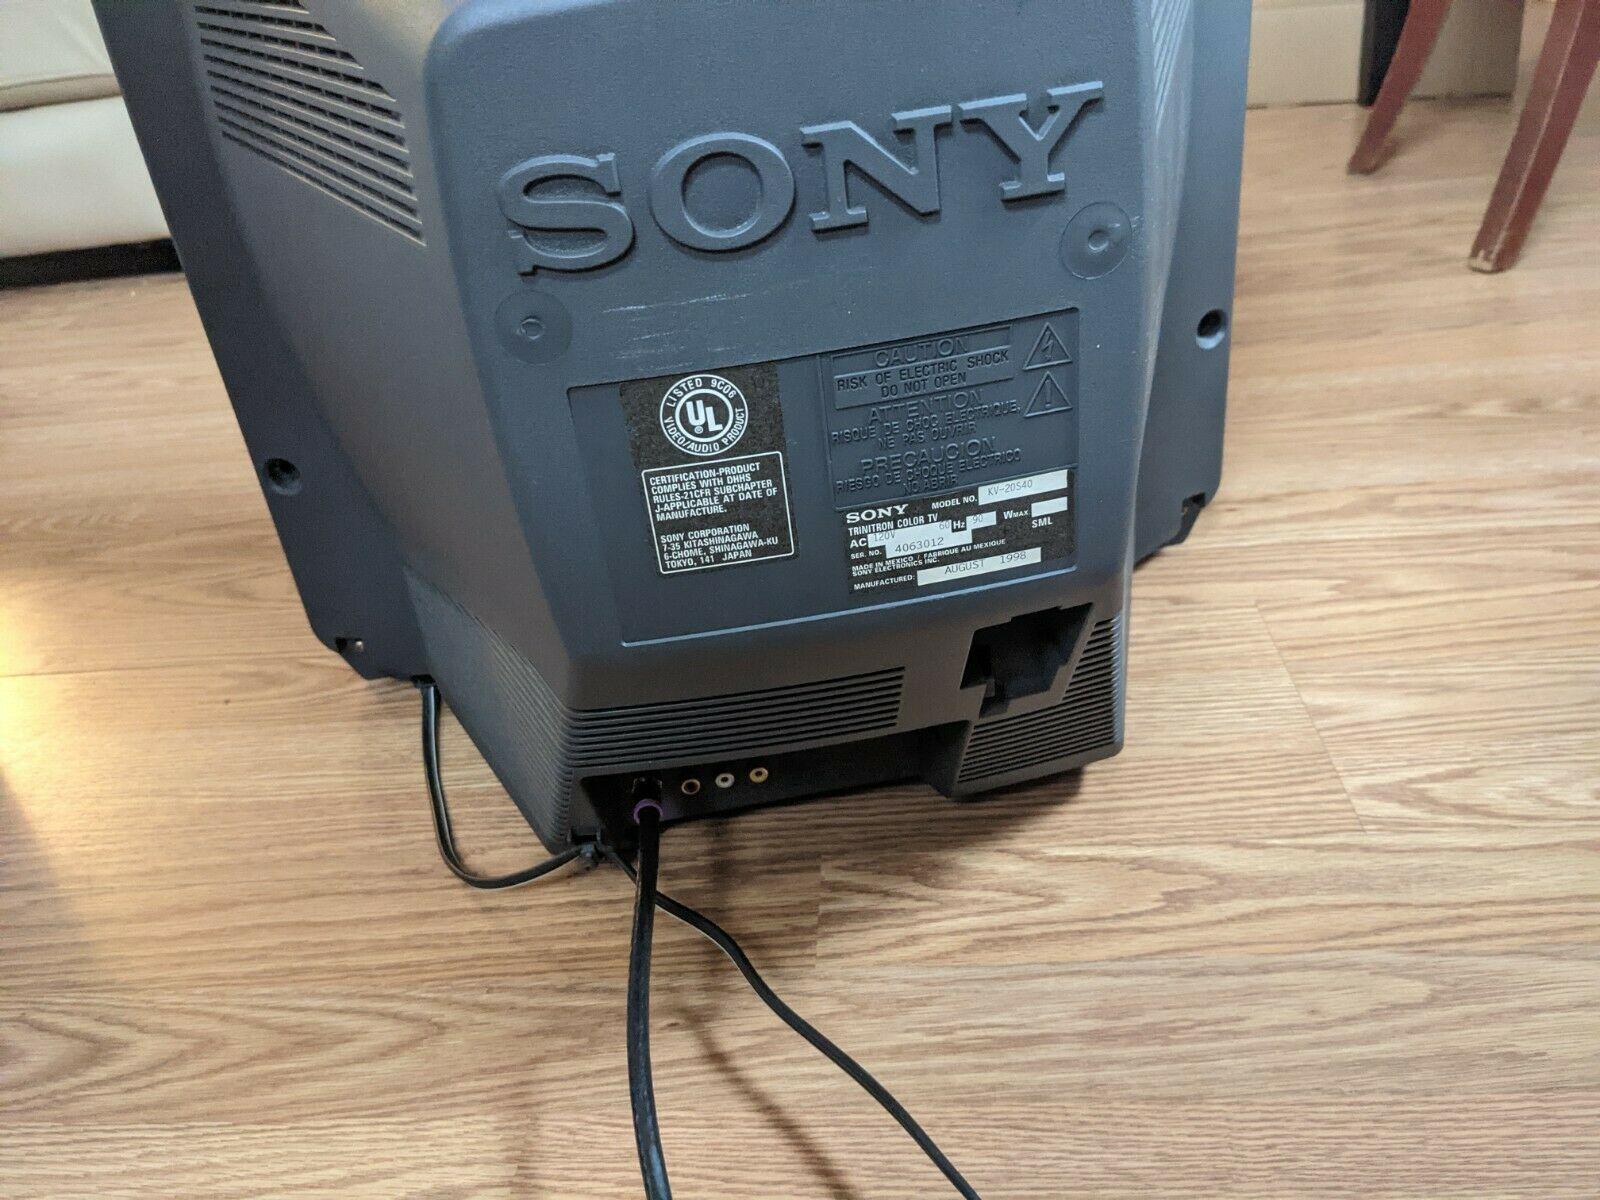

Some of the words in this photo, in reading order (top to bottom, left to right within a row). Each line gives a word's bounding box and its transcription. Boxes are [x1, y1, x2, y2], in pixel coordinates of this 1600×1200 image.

[499, 79, 1104, 276] SONY
[875, 338, 967, 367] CAUTION
[837, 376, 867, 392] RISK
[875, 371, 891, 386] OF
[900, 360, 958, 381] ELECTRIC
[967, 350, 1009, 369] SHOCK
[666, 378, 702, 407] LISTED
[710, 378, 737, 399] 9C06
[881, 385, 899, 399] DO
[904, 379, 928, 394] NOT
[934, 372, 967, 389] OPEN
[686, 400, 723, 432] UL
[868, 388, 982, 425] ATTENTION
[664, 416, 720, 453] VIDEO/AUDIO
[721, 408, 745, 446] PRODUCT
[831, 425, 877, 445] RISQUE
[883, 421, 900, 436] DE
[906, 414, 939, 432] CHOC
[878, 435, 896, 450] NE
[902, 430, 925, 445] PAS
[932, 421, 977, 441] OUVRIR
[861, 436, 996, 473] PRECAUCION
[649, 462, 761, 486] CERTIFICATION-PRODUCT
[835, 474, 880, 494] RIESGO
[885, 472, 901, 485] DE
[905, 462, 954, 481] CHOQUE
[958, 447, 1021, 472] ELECTRICO
[651, 481, 697, 495] COMPLIES
[699, 476, 724, 489] WITH
[727, 473, 752, 485] DHHS
[652, 487, 711, 504] RULES-21CFR
[714, 479, 773, 496] SUBCHAPTER
[903, 481, 919, 496] NO
[923, 474, 958, 492] ABRIR
[654, 497, 719, 513] J-APPLICABLE
[723, 494, 734, 504] AT
[738, 490, 763, 501] DATE
[766, 487, 778, 497] OF
[931, 498, 961, 510] MODEL
[962, 495, 978, 504] NO.
[656, 505, 727, 522] MANUFACTURE.
[845, 504, 909, 524] SONY
[848, 521, 894, 537] TRINITRON
[897, 515, 925, 528] COLOR
[927, 512, 939, 522] TV
[1031, 517, 1053, 529] SML
[660, 532, 685, 544] SONY
[687, 523, 750, 540] CORPORATION
[662, 542, 681, 552] 7-35
[683, 531, 759, 548] KITASHINAGAWA
[709, 536, 779, 555] SHINAGAWA-KU
[849, 537, 868, 549] AC
[873, 530, 896, 541] 120V
[953, 520, 966, 530] Hz
[700, 555, 715, 564] 141
[722, 550, 752, 562] JAPAN
[850, 552, 867, 560] SER.
[868, 549, 882, 557] NO.
[894, 536, 945, 553] 4063012
[852, 561, 874, 572] MADE
[886, 556, 914, 567] MEXICO
[960, 545, 972, 554] AU
[973, 539, 1006, 550] MEXIQUE
[852, 568, 874, 577] SONY
[875, 560, 923, 574] ELECTRONICS
[925, 558, 940, 566] INC.
[853, 575, 916, 591] MANUFACTURED:
[944, 560, 985, 575] AUGUST
[1000, 551, 1027, 564] 1998
